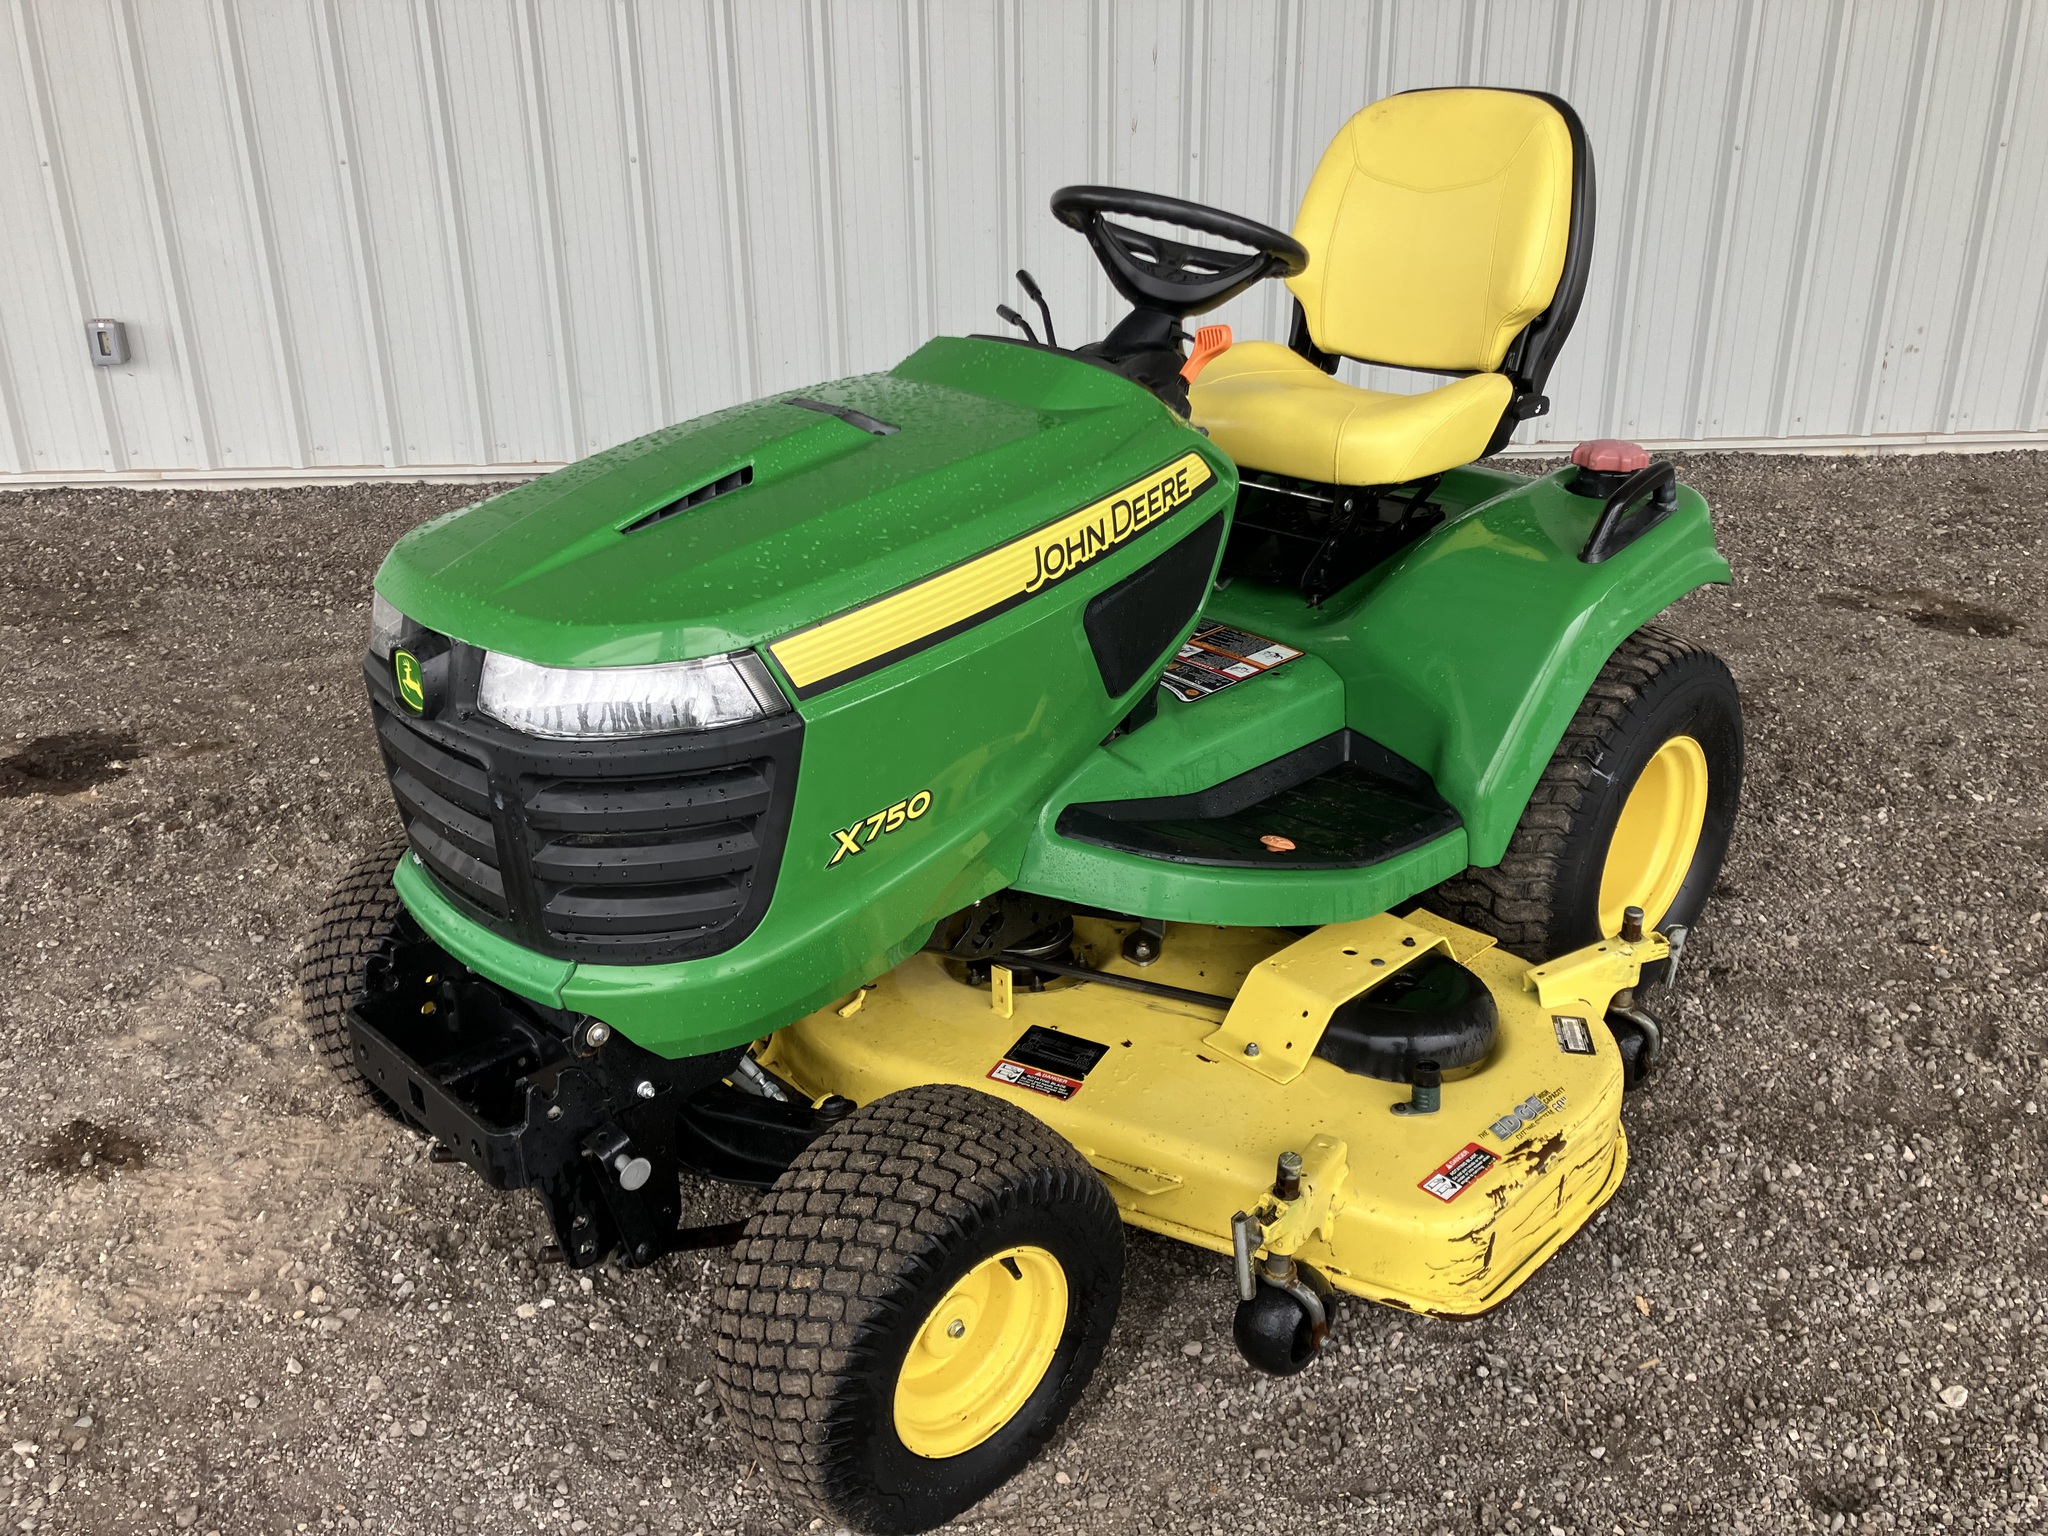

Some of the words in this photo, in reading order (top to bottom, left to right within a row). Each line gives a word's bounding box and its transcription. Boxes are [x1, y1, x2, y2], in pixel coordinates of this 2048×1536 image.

[1025, 517, 1107, 591] JOHN
[1111, 466, 1190, 542] DEERE
[825, 790, 932, 868] X750
[1041, 1073, 1068, 1084] DANGER
[1542, 1086, 1565, 1104] CAPACITY
[1478, 1130, 1489, 1139] THE
[1488, 1095, 1548, 1142] EDGE
